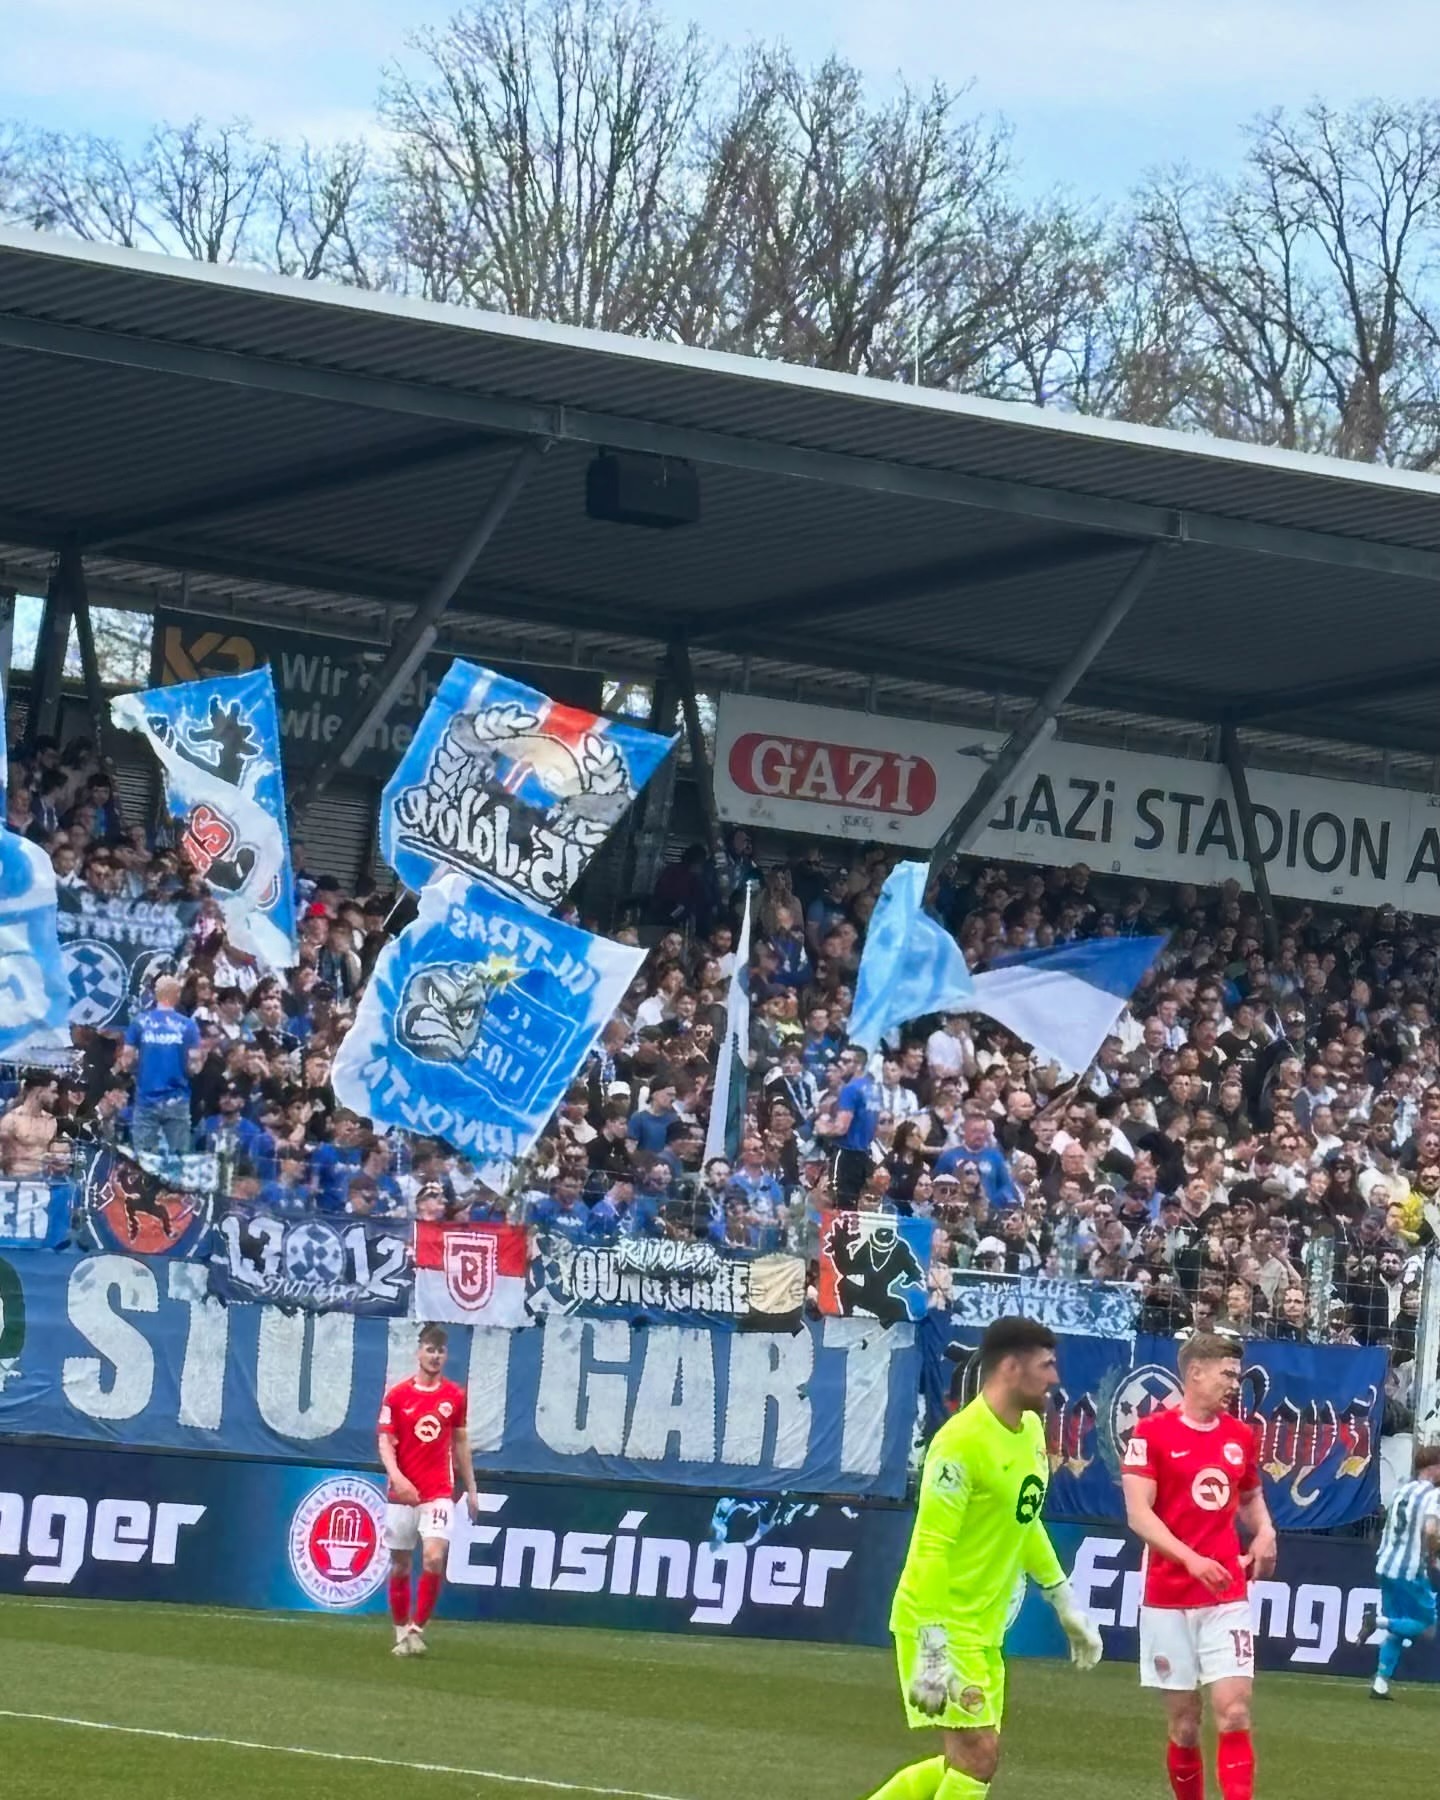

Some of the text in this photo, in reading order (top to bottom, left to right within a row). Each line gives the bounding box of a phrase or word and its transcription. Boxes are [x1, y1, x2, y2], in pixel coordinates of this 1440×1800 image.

[281, 652, 349, 697] Wir
[279, 702, 343, 743] wie
[1134, 788, 1391, 881] STADION
